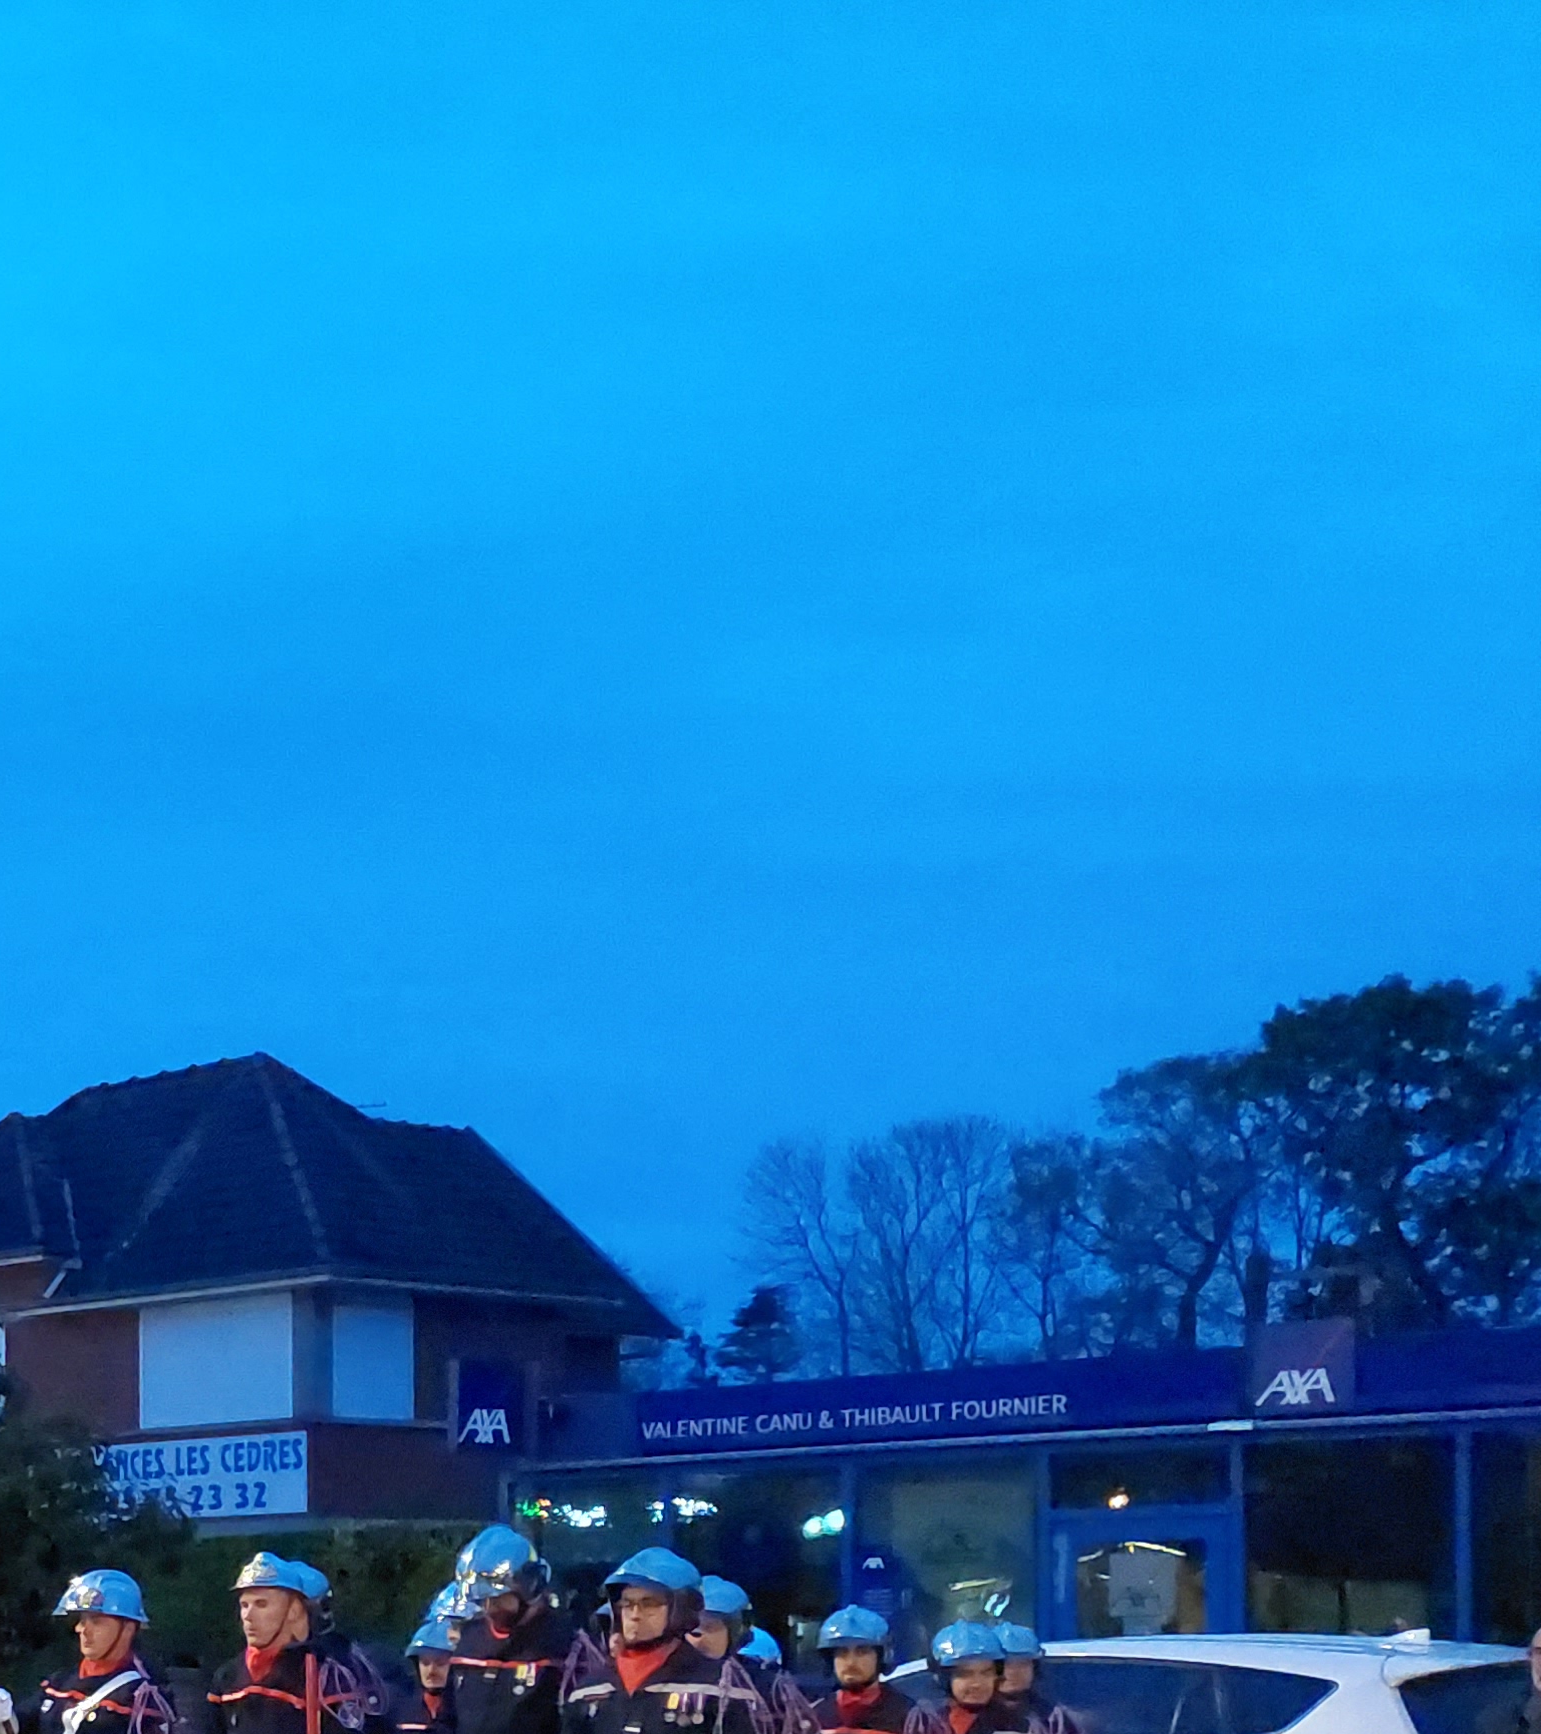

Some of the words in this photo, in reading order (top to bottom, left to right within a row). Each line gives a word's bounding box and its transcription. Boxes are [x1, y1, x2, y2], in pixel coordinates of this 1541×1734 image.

[1255, 1367, 1336, 1407] AXA
[458, 1408, 511, 1444] AXA
[642, 1416, 749, 1440] VALENTINE
[755, 1411, 813, 1434] CANU
[818, 1409, 834, 1429] &
[840, 1402, 944, 1428] THIBAULT
[949, 1394, 1067, 1421] FOURNIER
[175, 1444, 210, 1477] LES
[220, 1438, 304, 1473] CEDRES
[188, 1484, 222, 1512] 23
[235, 1481, 267, 1509] 32
